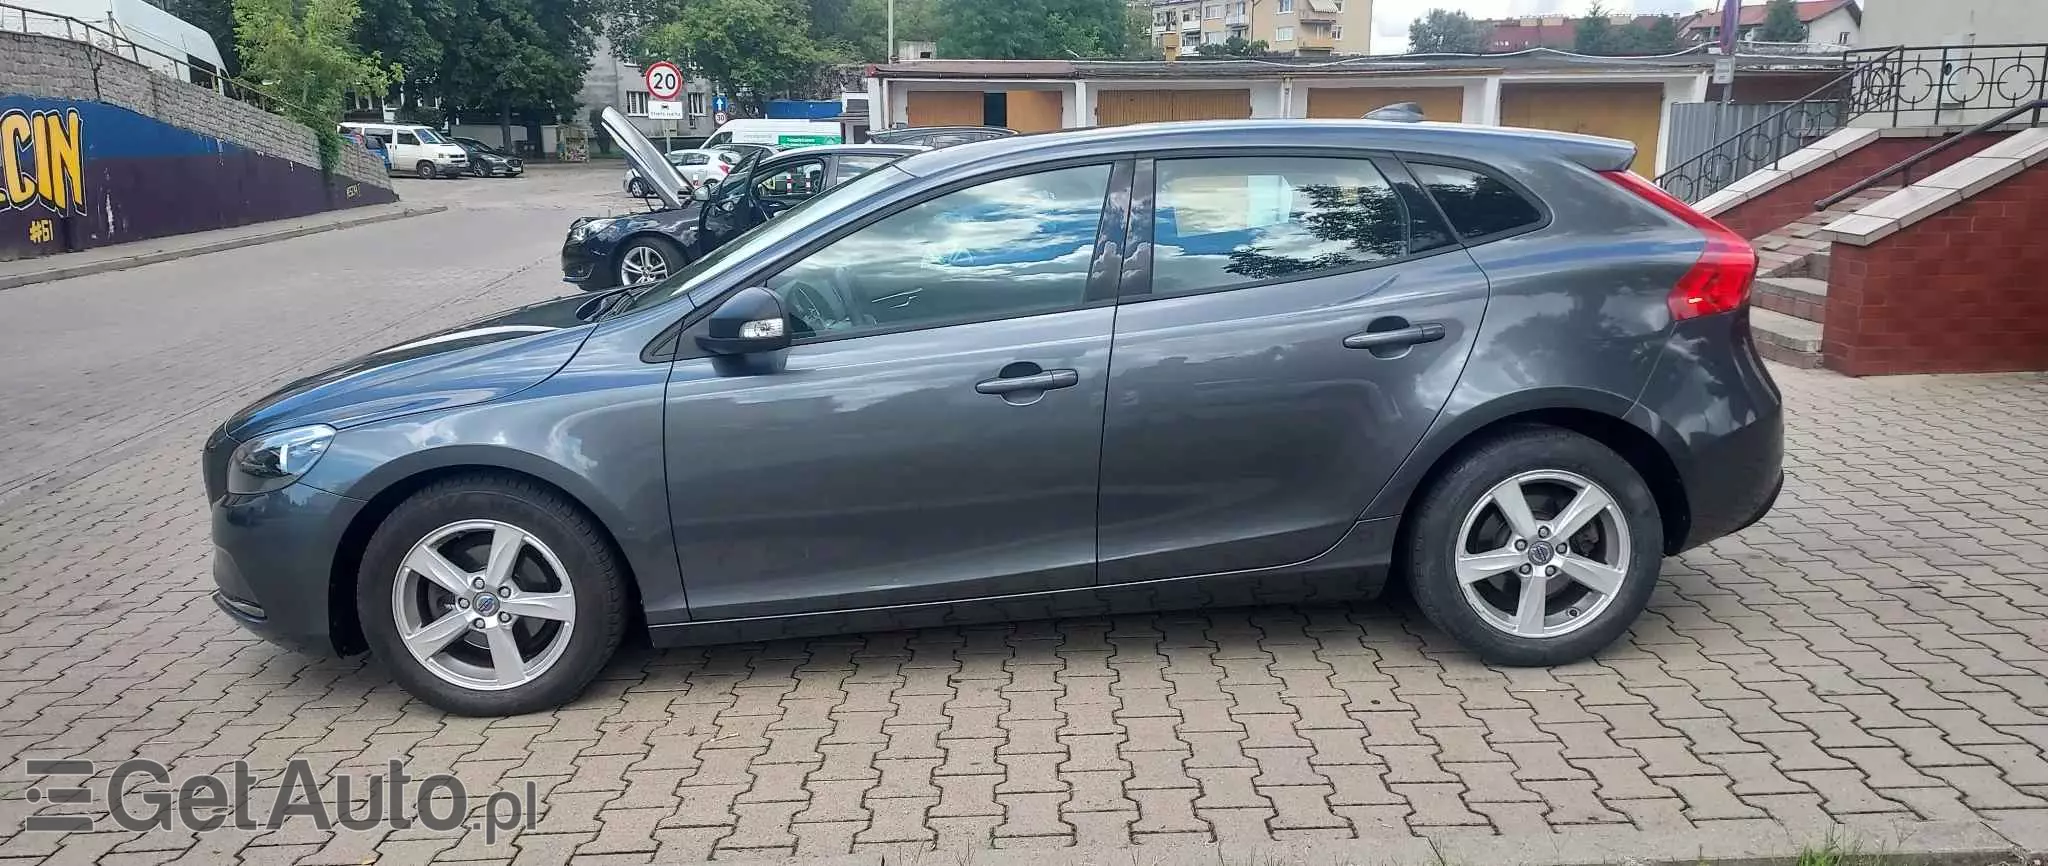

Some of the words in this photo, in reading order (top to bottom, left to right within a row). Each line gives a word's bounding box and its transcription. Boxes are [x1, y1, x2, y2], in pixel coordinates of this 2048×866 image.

[653, 72, 676, 90] 20
[0, 110, 86, 216] CIN
[29, 219, 54, 243] #61
